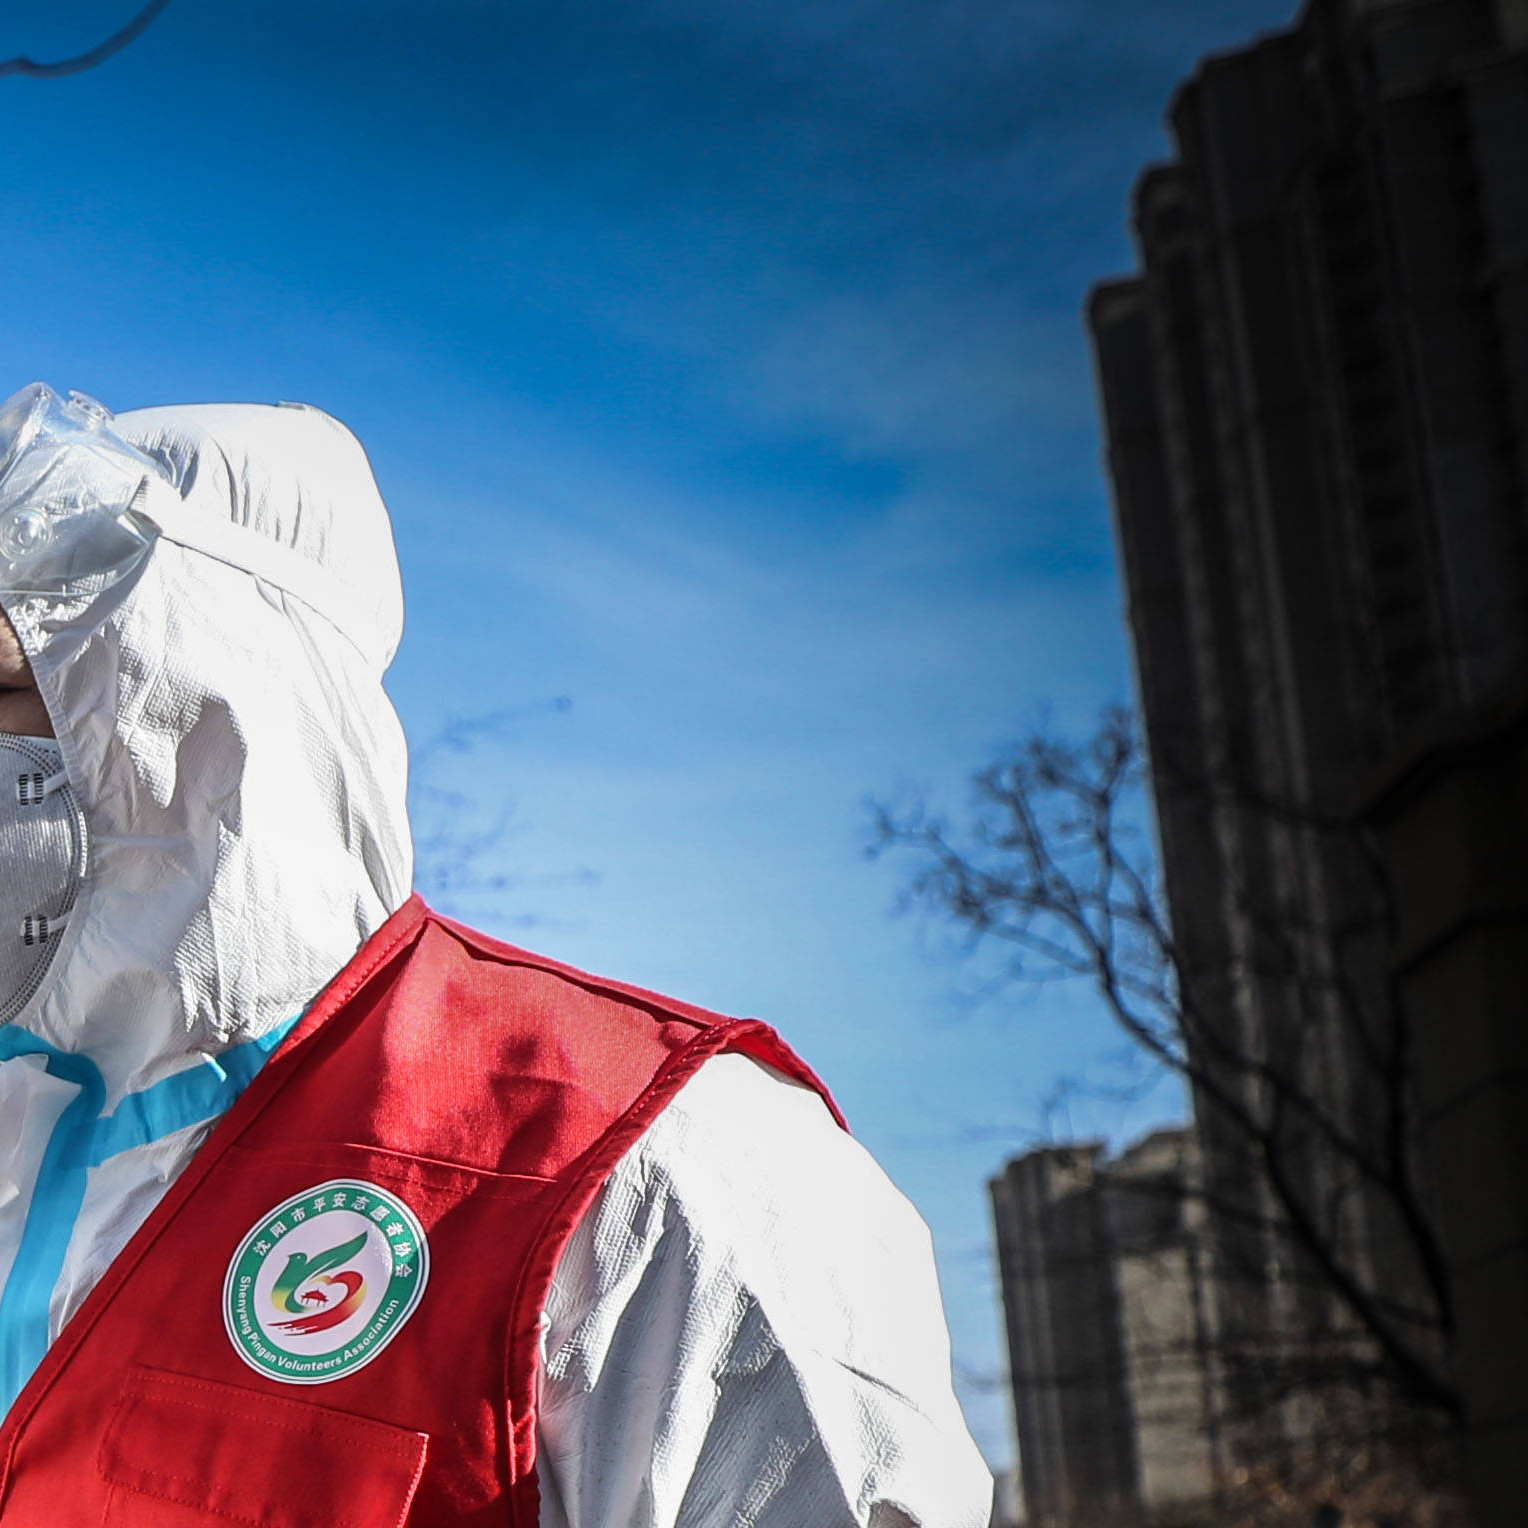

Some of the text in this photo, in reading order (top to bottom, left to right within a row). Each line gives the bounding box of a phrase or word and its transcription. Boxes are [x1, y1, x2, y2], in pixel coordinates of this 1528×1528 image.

[252, 1191, 413, 1278] 沈阳市平安志愿者协会
[236, 1275, 400, 1372] Shenyang Pingan Volunteers Association
